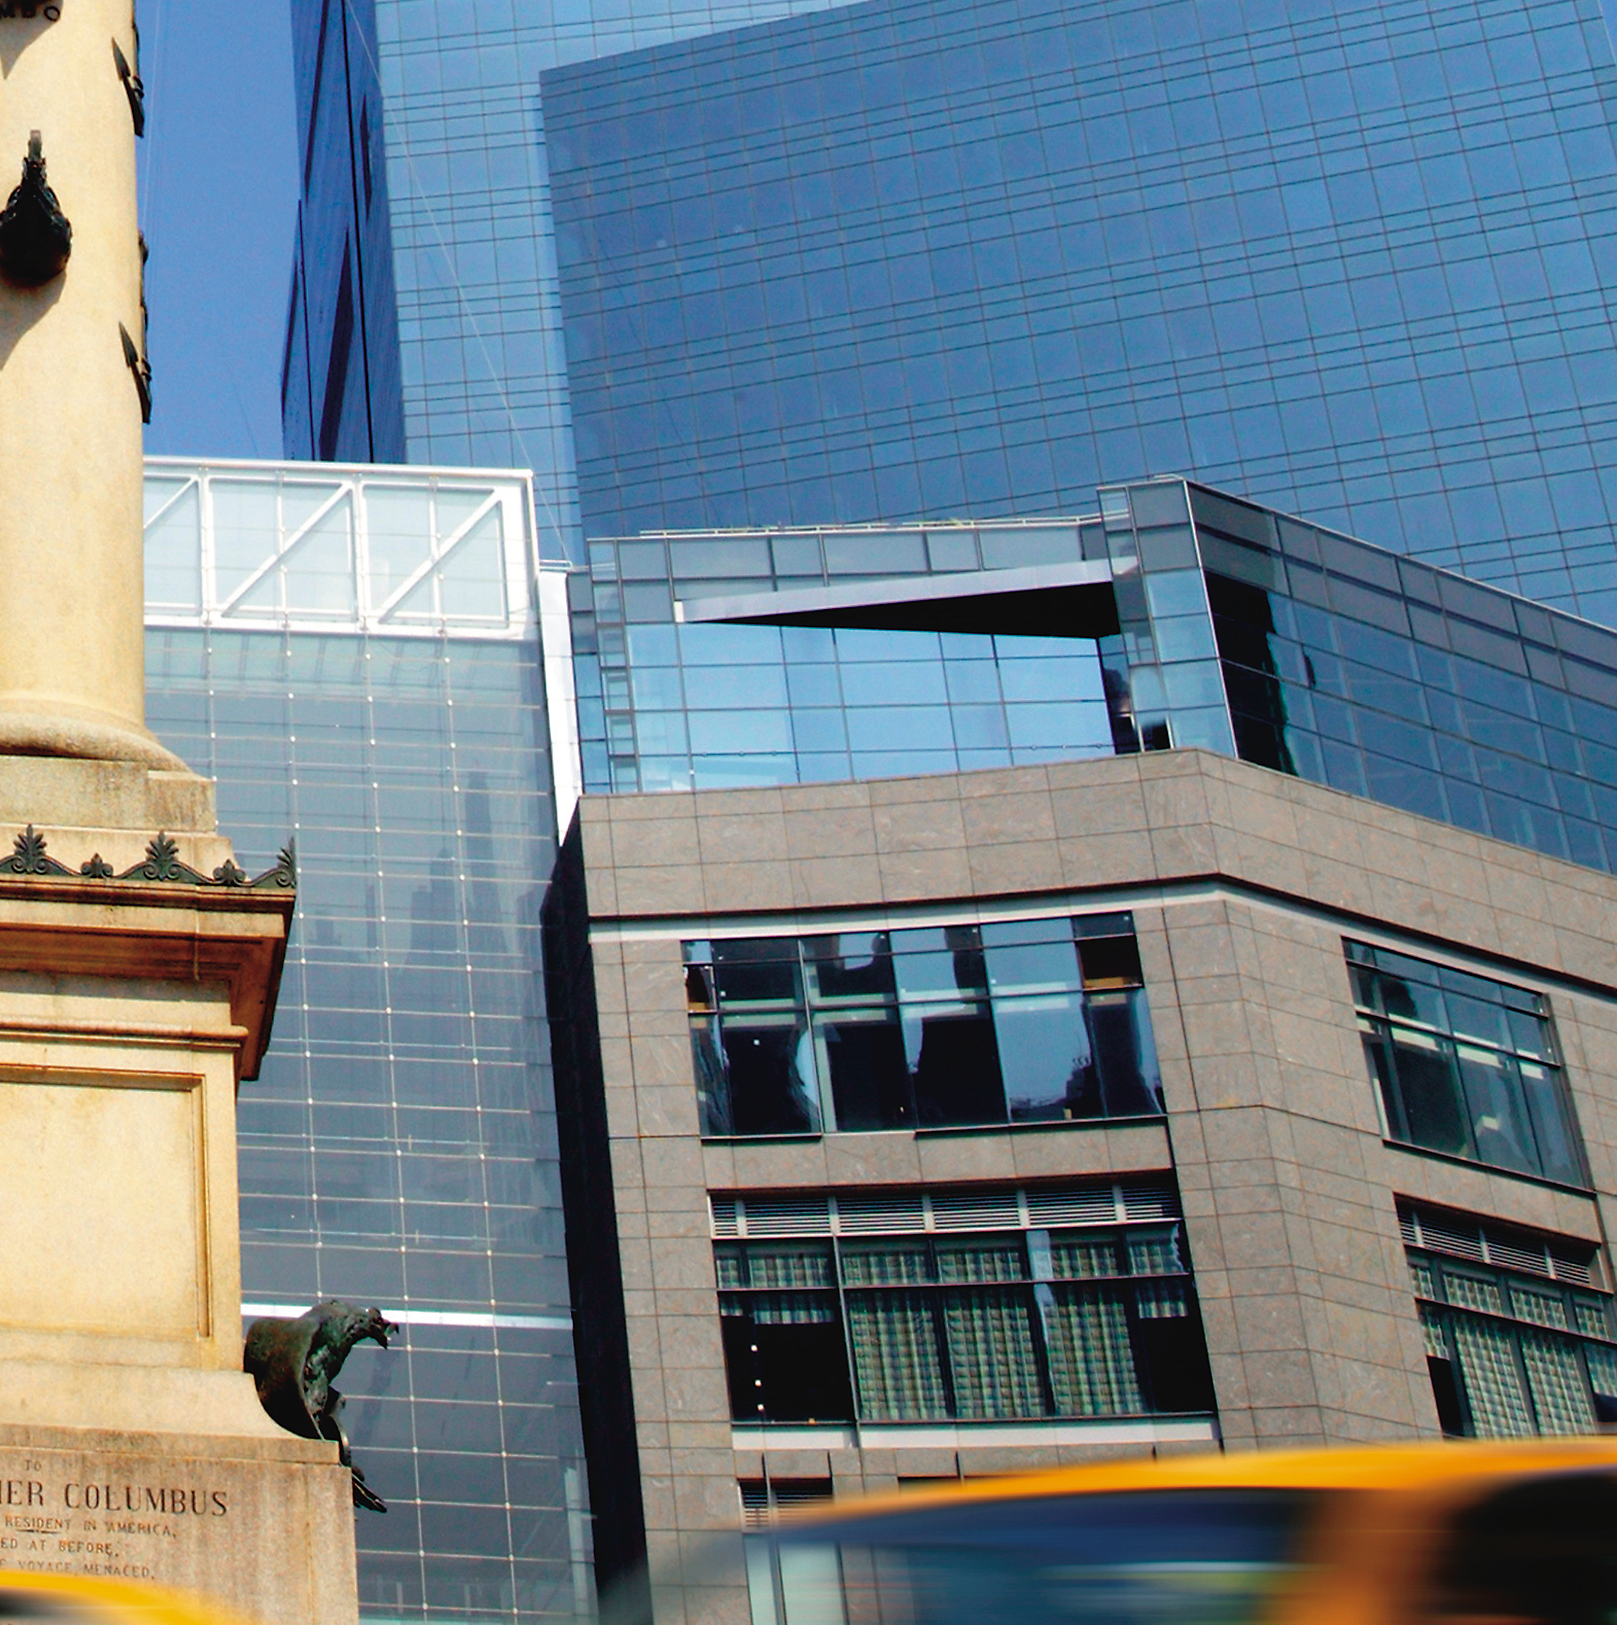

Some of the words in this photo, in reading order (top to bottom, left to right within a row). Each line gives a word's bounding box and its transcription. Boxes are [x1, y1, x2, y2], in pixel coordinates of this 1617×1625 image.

[25, 1460, 41, 1472] TO
[64, 1482, 228, 1517] COLUMBUS
[5, 1515, 72, 1531] RESIDENT
[83, 1519, 97, 1531] IN
[29, 1539, 46, 1551] AT
